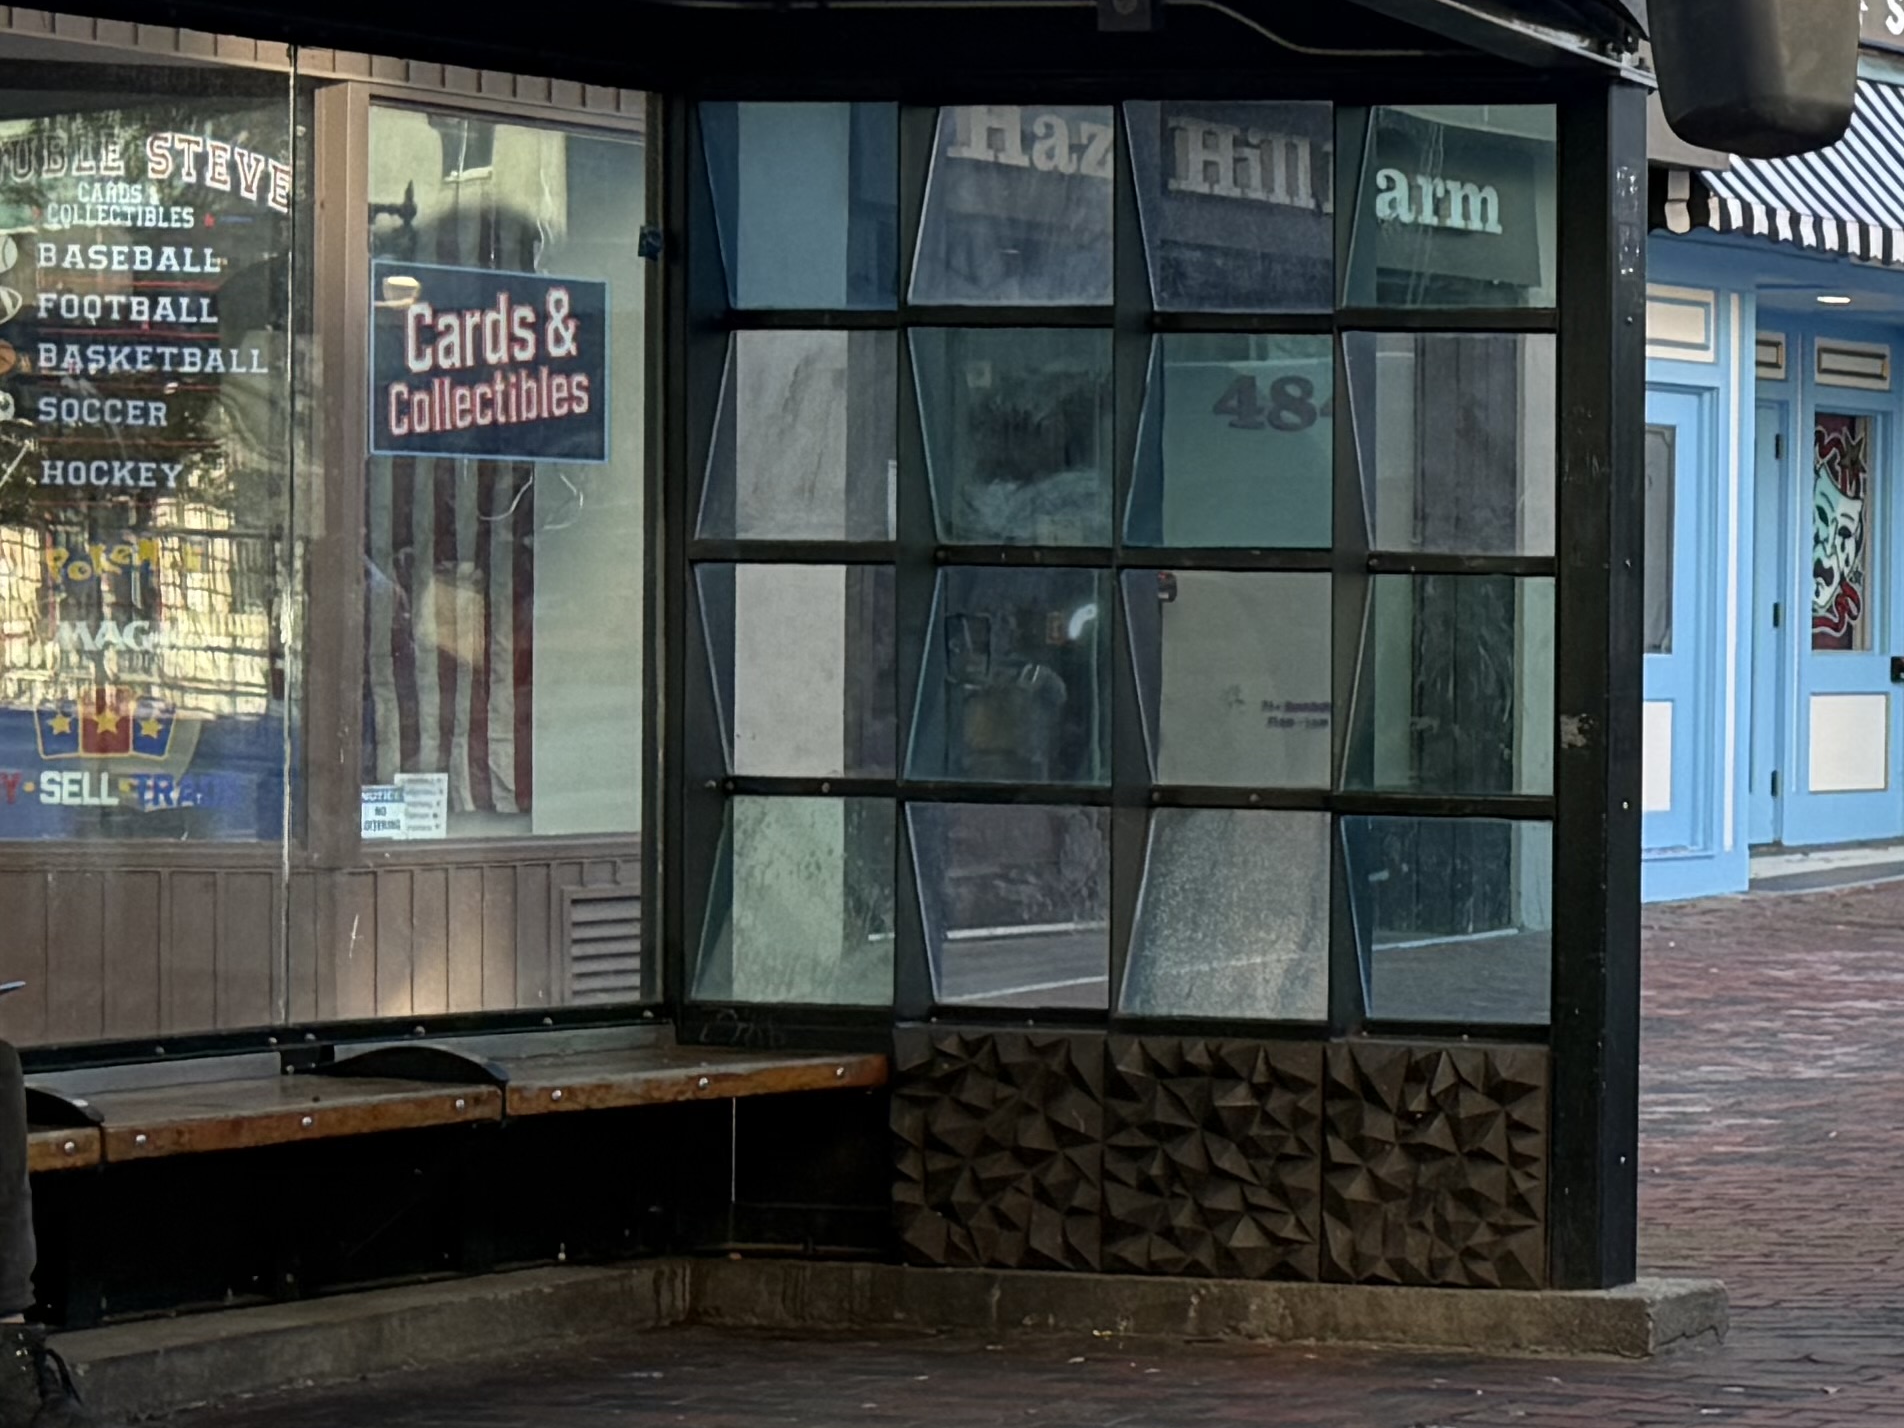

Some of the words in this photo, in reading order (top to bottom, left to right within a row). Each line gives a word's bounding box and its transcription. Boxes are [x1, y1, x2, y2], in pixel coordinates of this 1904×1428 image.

[1168, 115, 1316, 211] Hill
[1375, 167, 1503, 235] arm
[77, 181, 142, 204] CARDS
[46, 203, 195, 229] COLLECTIBLES
[37, 242, 222, 273] BASEBALL
[37, 293, 219, 323] FOOTBALL
[405, 291, 537, 373] Cards
[545, 285, 580, 358] &
[37, 342, 270, 373] BASKETBALL
[38, 397, 168, 427] SOCCER
[388, 365, 592, 437] Collectibles
[1212, 374, 1333, 433] 48
[40, 459, 184, 488] HOCKEY
[39, 770, 120, 806] SELL
